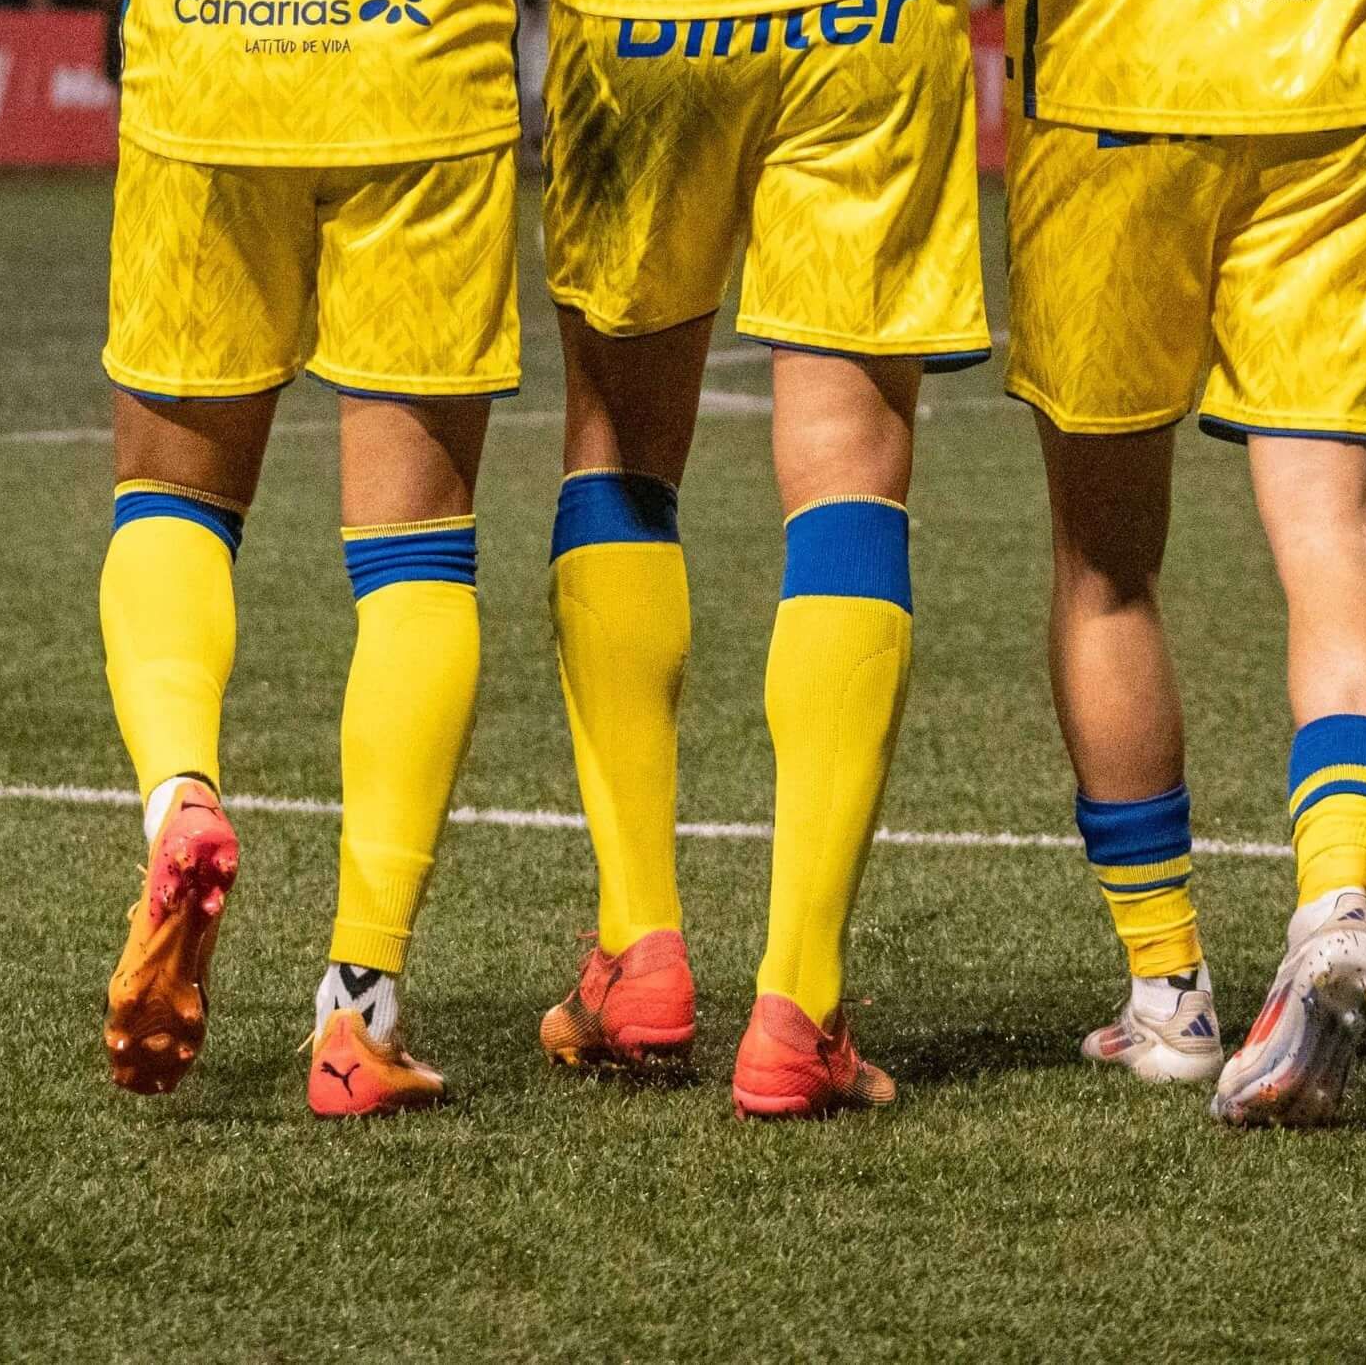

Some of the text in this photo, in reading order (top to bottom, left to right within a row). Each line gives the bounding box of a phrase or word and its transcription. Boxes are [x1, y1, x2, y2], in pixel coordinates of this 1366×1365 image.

[245, 38, 352, 54] LATITUD DE VIDA
